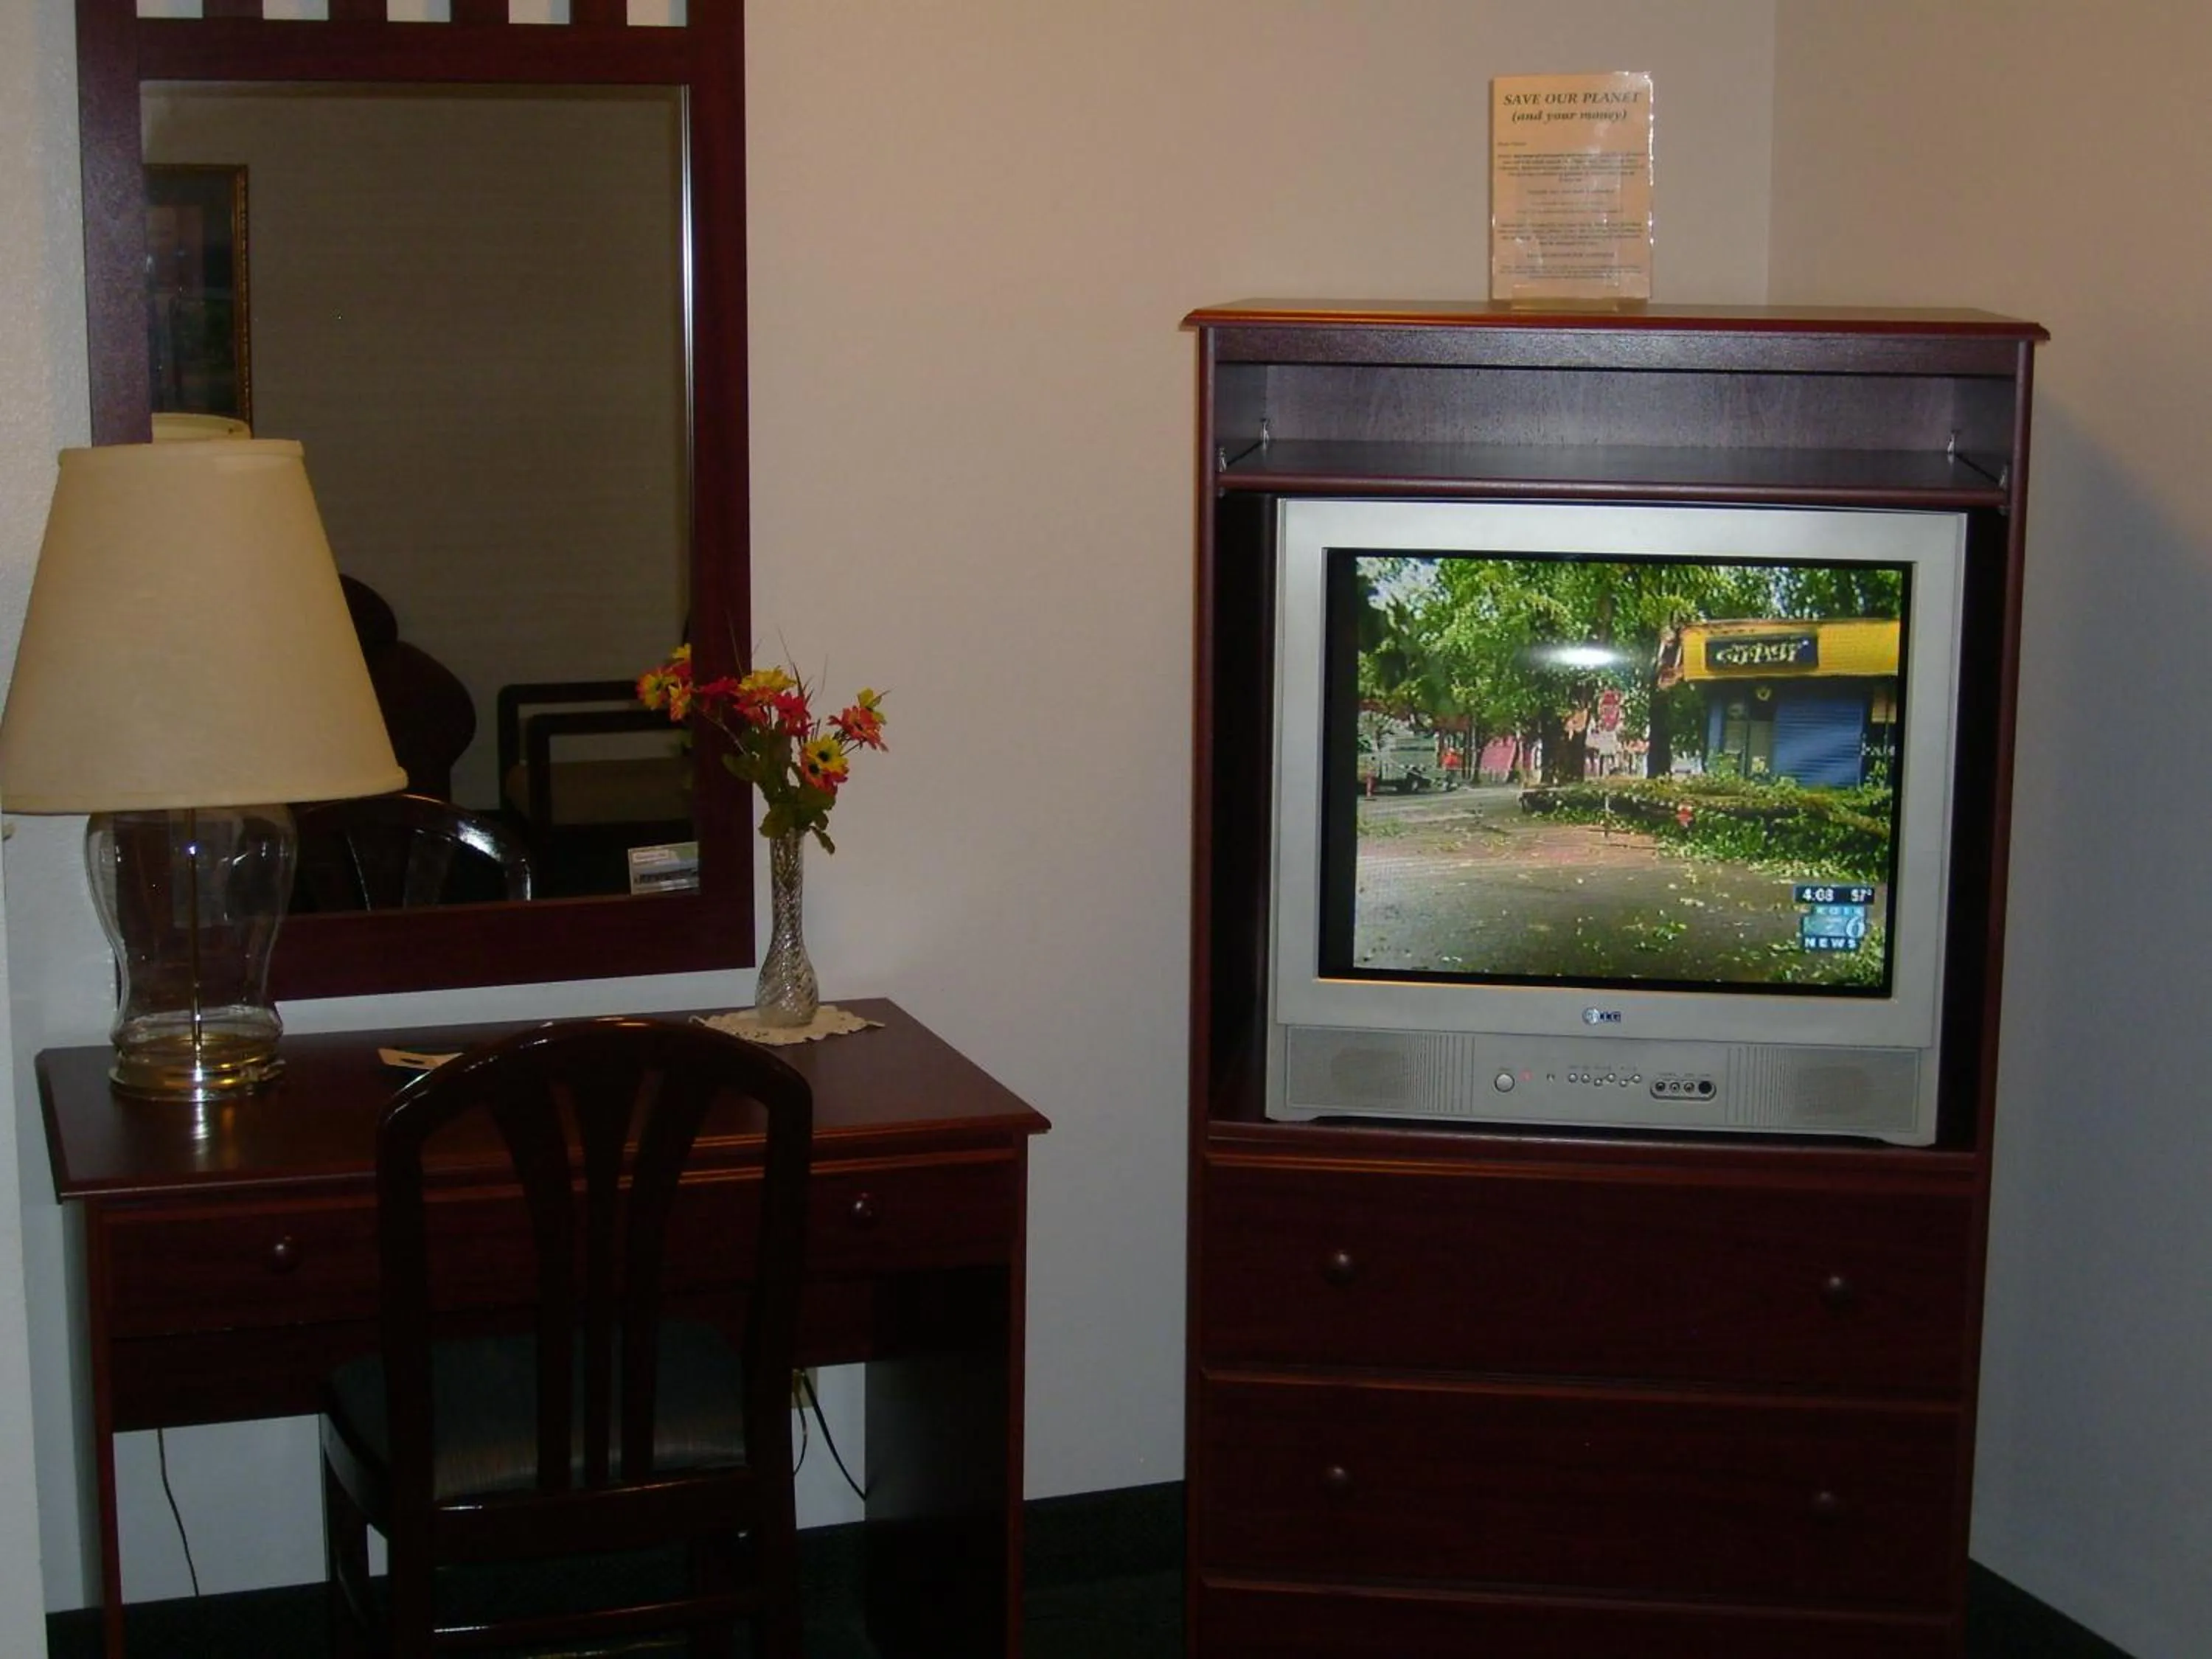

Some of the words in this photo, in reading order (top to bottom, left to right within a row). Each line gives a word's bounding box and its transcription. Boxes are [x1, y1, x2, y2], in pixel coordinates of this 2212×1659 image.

[1503, 94, 1540, 105] SAVE
[1545, 93, 1578, 104] OUR
[1582, 92, 1641, 103] PLANET
[1512, 111, 1543, 122] (and
[1545, 112, 1577, 124] your
[1580, 110, 1627, 125] money)
[1804, 937, 1857, 949] NEWS
